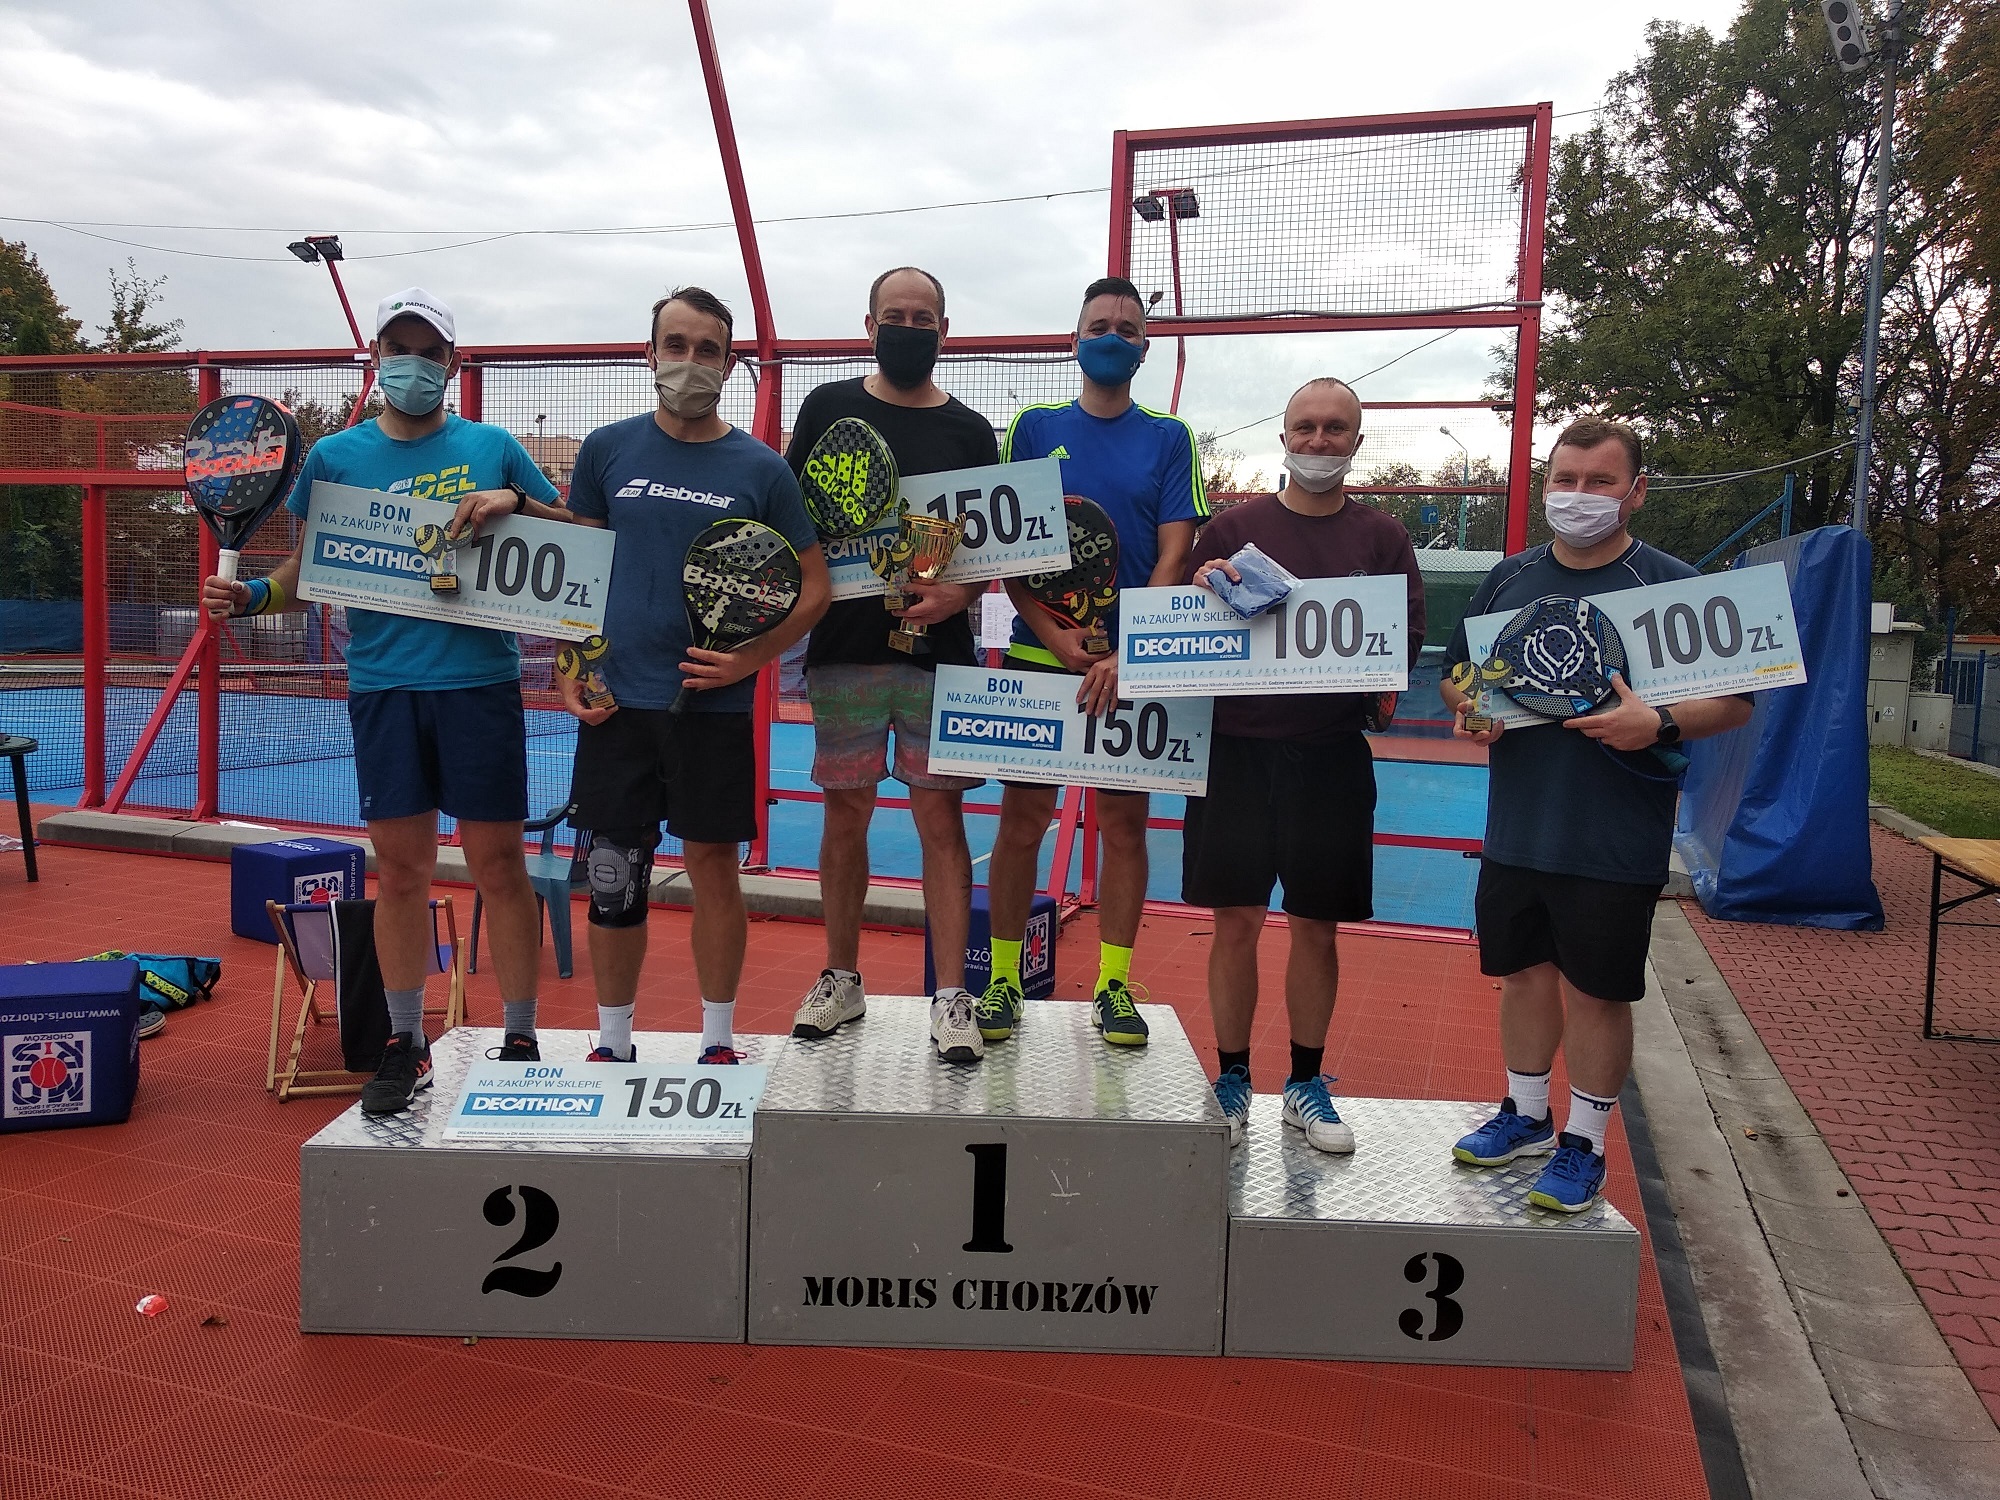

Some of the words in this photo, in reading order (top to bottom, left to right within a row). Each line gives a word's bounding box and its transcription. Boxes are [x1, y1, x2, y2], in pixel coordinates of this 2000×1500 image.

[405, 302, 442, 317] PADELTEAM
[806, 459, 868, 526] adidas
[370, 502, 411, 523] BON
[320, 512, 337, 524] NA
[341, 516, 388, 533] ZAKUPY
[393, 525, 403, 535] W
[323, 540, 441, 574] DECATHLON
[822, 532, 900, 561] ECATHLO
[309, 585, 336, 595] DECATHLON
[684, 564, 798, 609] Babolat
[1171, 595, 1206, 610] BON
[1132, 615, 1147, 625] NA
[1149, 613, 1188, 624] ZAKUPY
[1191, 612, 1200, 622] W
[1134, 635, 1243, 657] DECATHLON
[987, 678, 1023, 694] BON
[947, 692, 961, 703] NA
[964, 694, 1006, 706] ZAKUPY
[1008, 697, 1018, 707] W
[1020, 698, 1061, 711] SKLEPIE
[947, 717, 1056, 743] DECATHLON
[0, 1009, 120, 1022] www.moris.chorzo
[525, 1067, 564, 1078] BON
[478, 1079, 494, 1087] NA
[496, 1080, 542, 1088] ZAKUPY
[544, 1080, 555, 1088] W
[558, 1080, 603, 1089] SKLEPIE
[472, 1096, 595, 1112] DECATHLON
[962, 1143, 1014, 1253] 1
[482, 1184, 562, 1298] 2
[802, 1276, 937, 1309] MORIS
[952, 1276, 1159, 1315] CHORZÓW
[1398, 1252, 1464, 1341] 3
